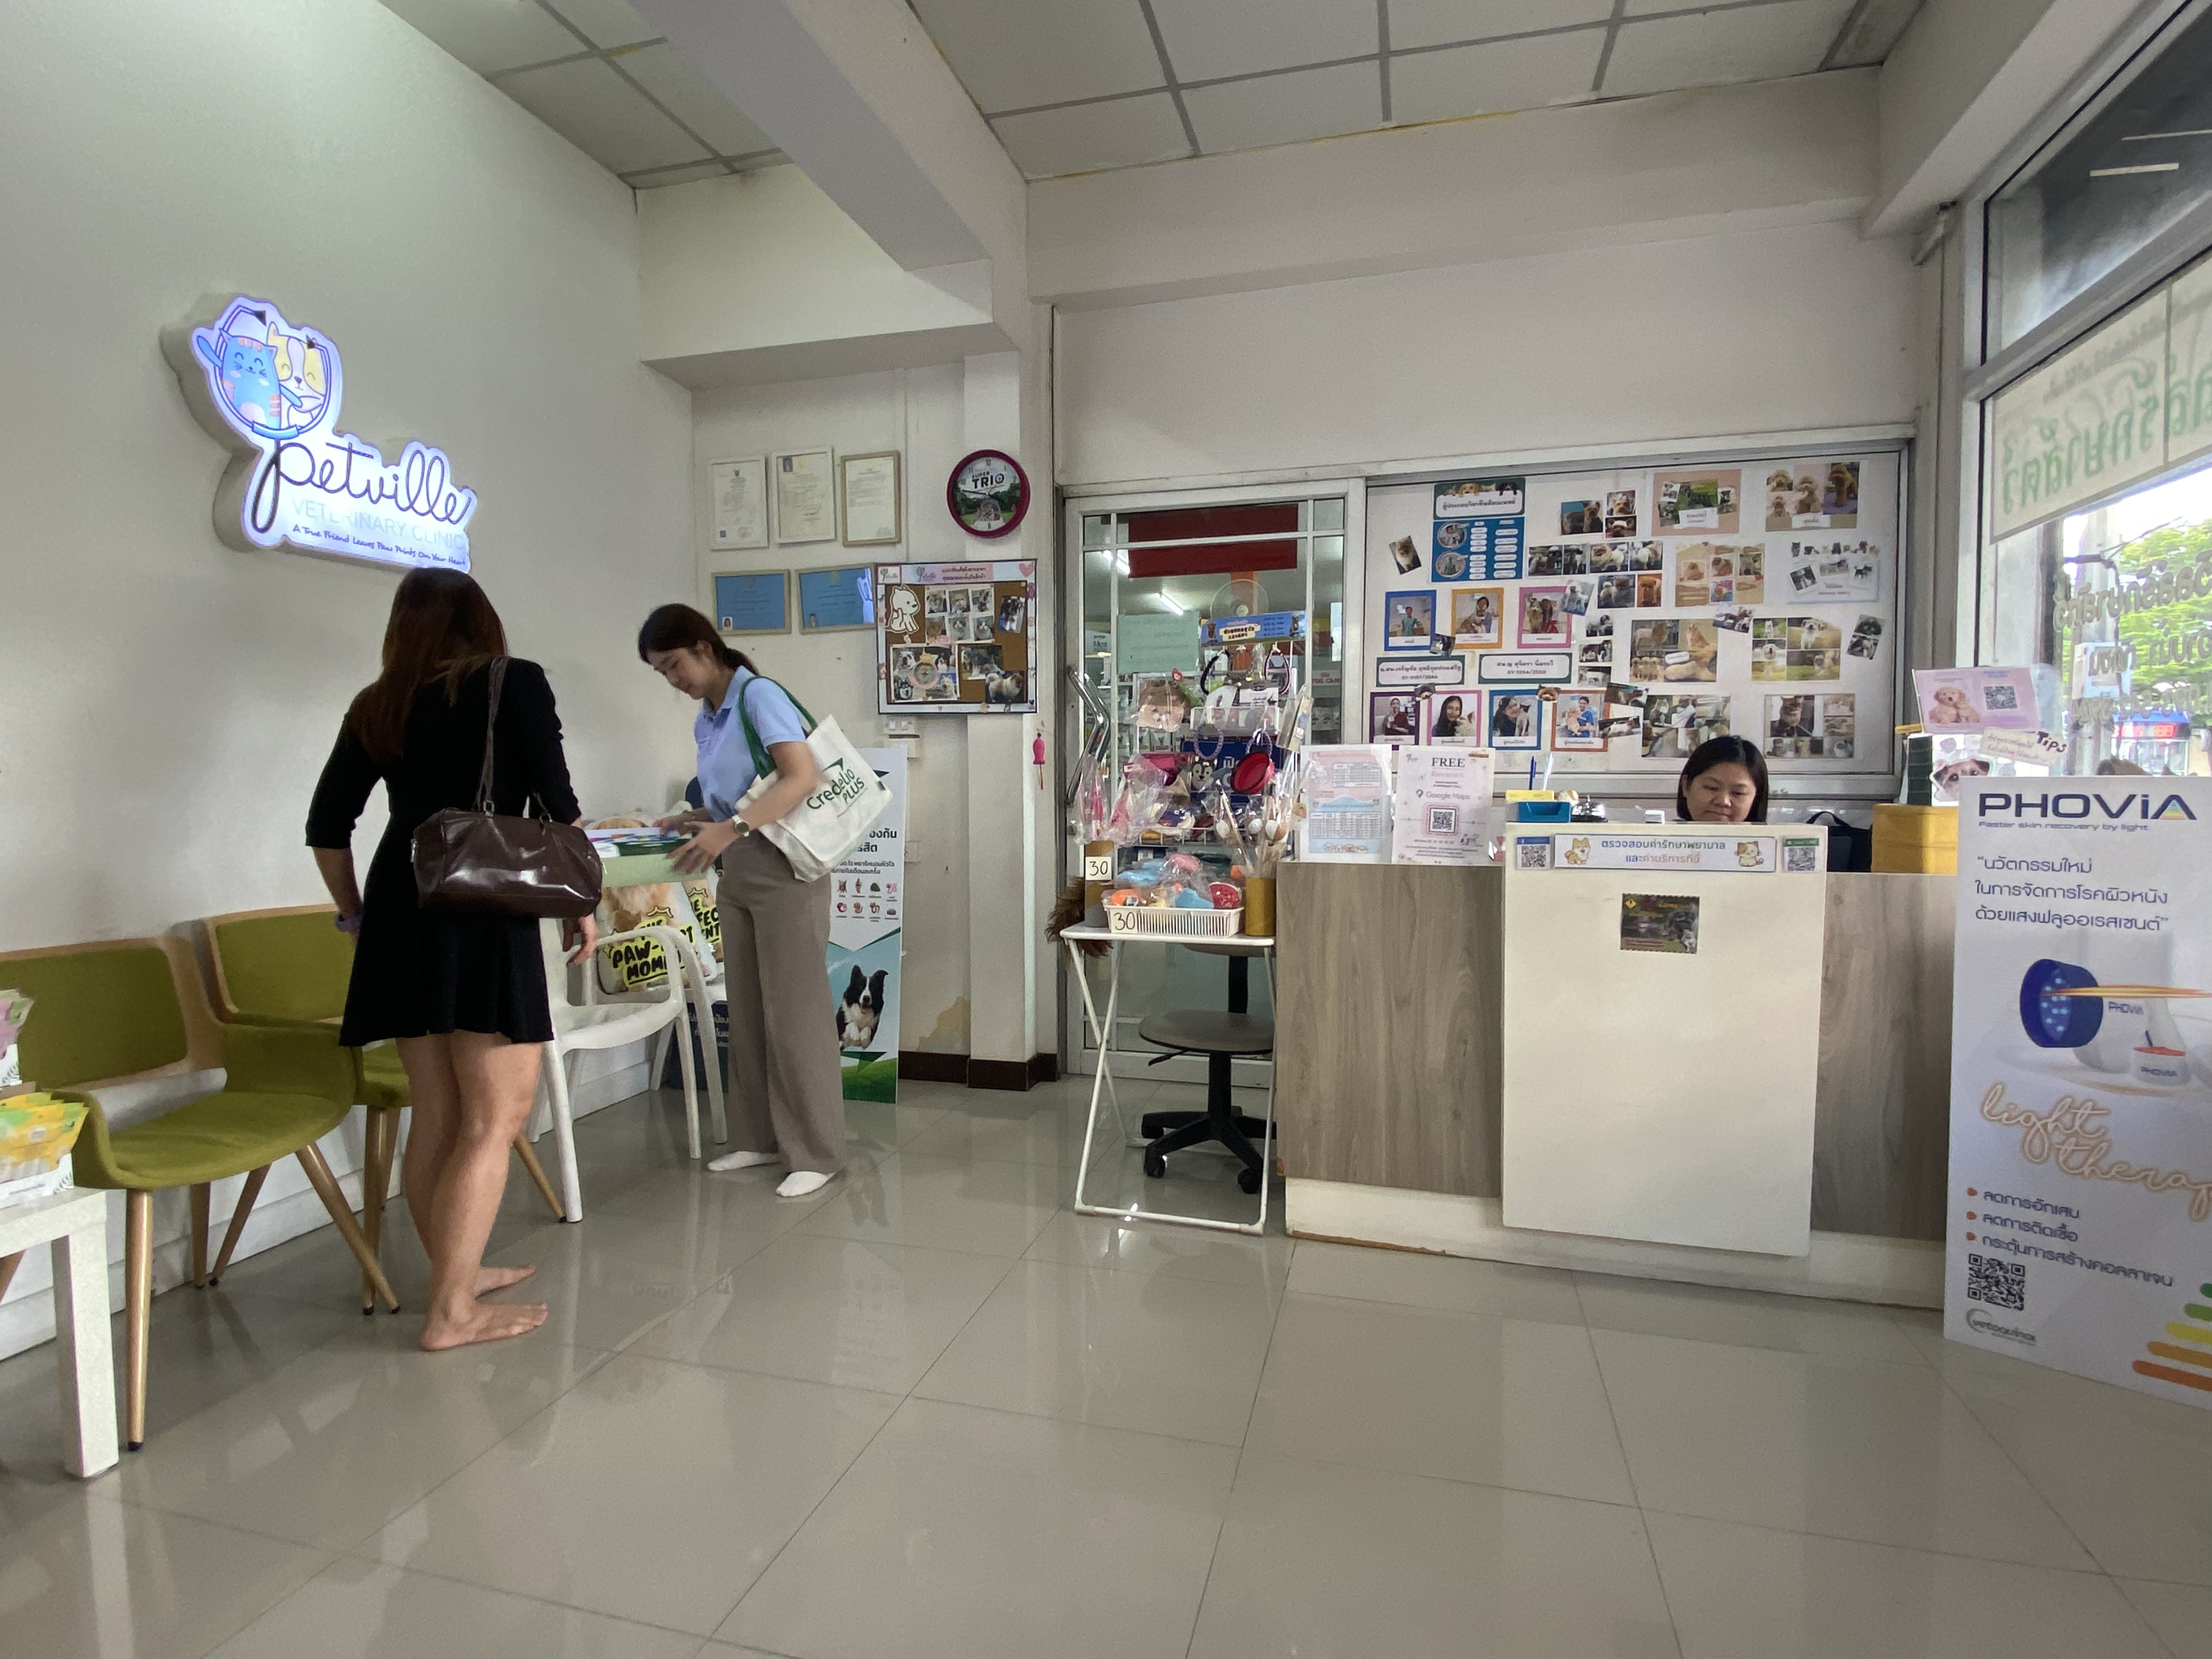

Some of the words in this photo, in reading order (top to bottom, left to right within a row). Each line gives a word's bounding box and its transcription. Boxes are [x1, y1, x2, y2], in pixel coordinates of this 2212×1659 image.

[971, 473, 1005, 489] TRIO
[292, 523, 300, 533] A
[302, 527, 321, 537] True
[323, 530, 349, 543] Friend
[352, 537, 375, 549] Leaves
[377, 541, 393, 551] Paw
[395, 545, 416, 557] Prints
[418, 551, 431, 559] On
[431, 553, 447, 562] Your
[448, 556, 466, 566] Heart
[413, 525, 464, 550] CLINIC
[2036, 731, 2067, 753] Tips
[1431, 757, 1466, 768] FREE
[806, 768, 855, 810] Credelio
[842, 777, 865, 805] PLUS
[1426, 791, 1451, 800] Google
[1452, 792, 1470, 800] Maps
[2045, 823, 2100, 832] recovery
[2102, 823, 2118, 832] by
[2121, 823, 2149, 833] light
[1088, 860, 1108, 876] 30
[1974, 879, 2168, 905] ในการจัดการโรคผิวหนัง
[1113, 911, 1136, 931] 30
[1982, 1081, 2111, 1164] light
